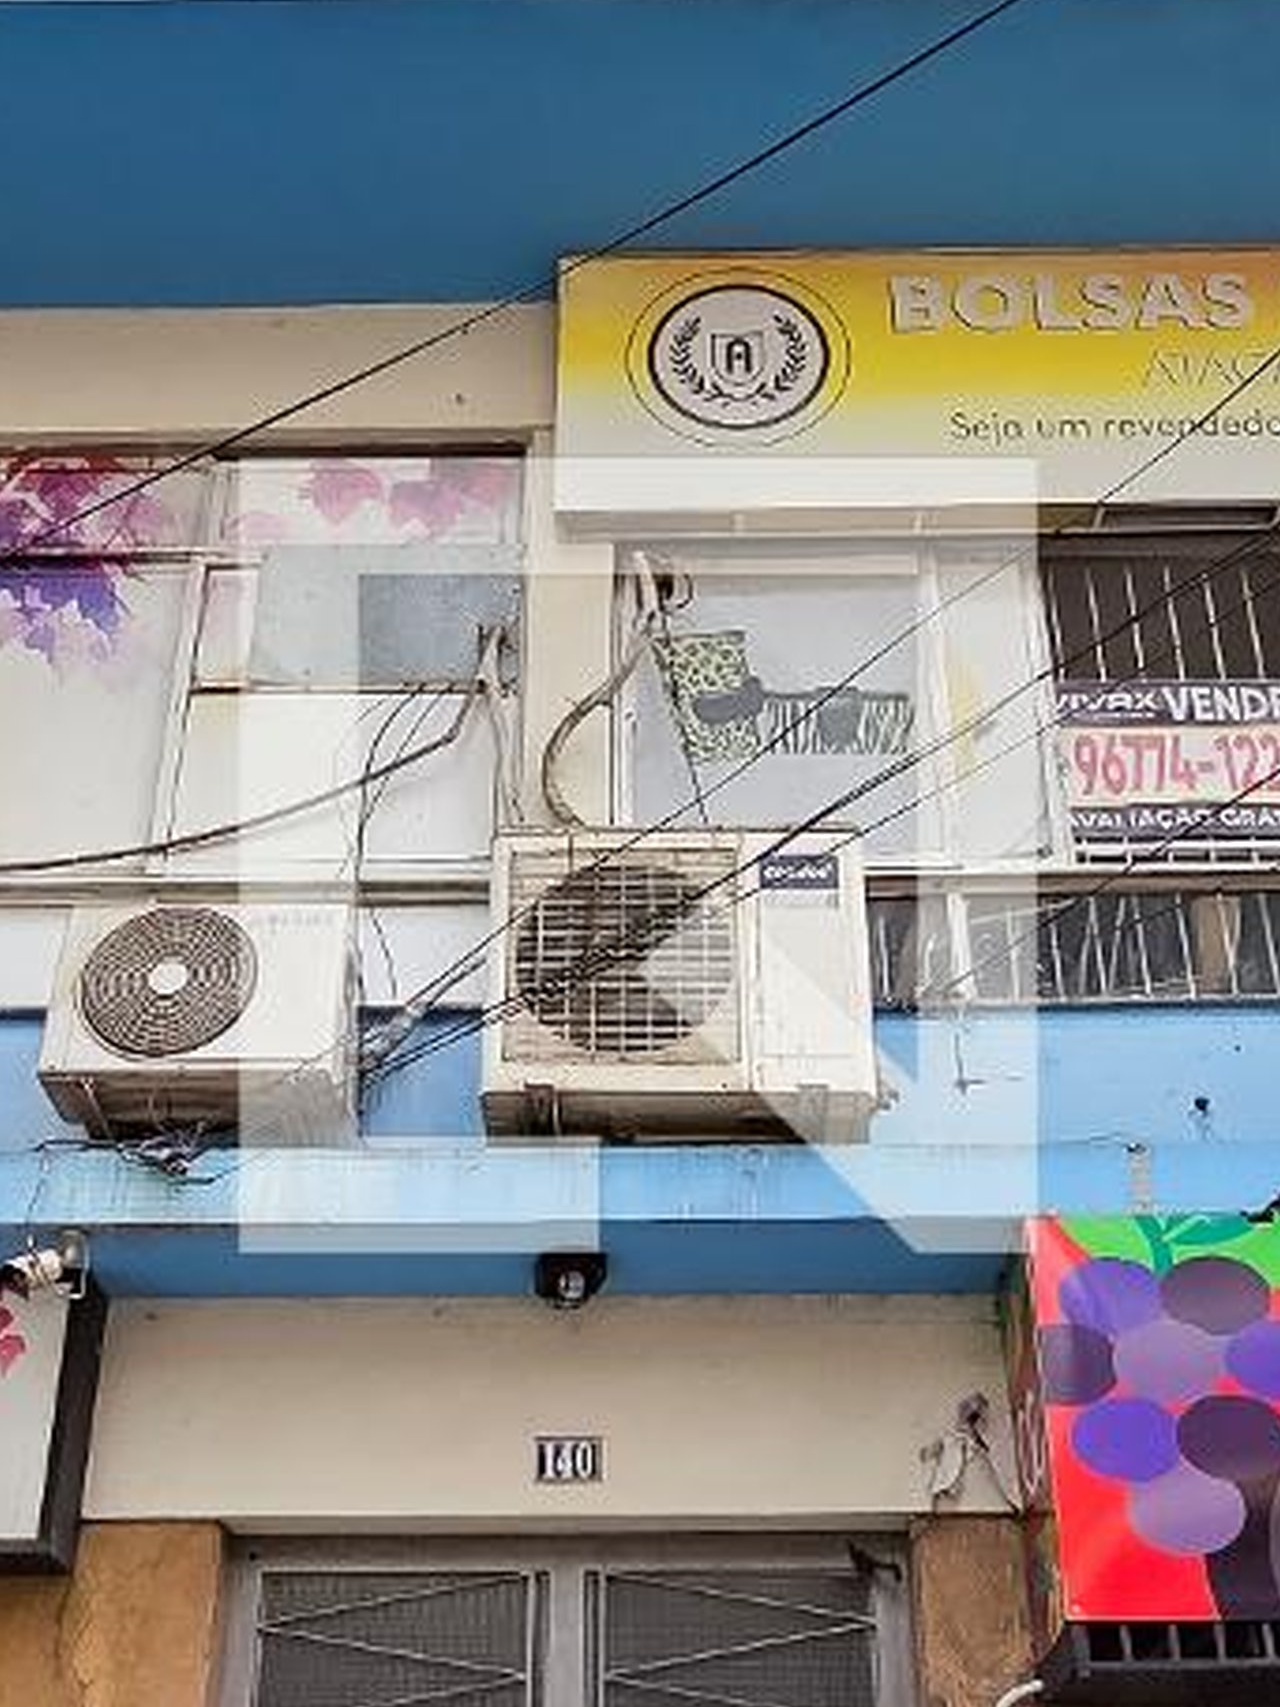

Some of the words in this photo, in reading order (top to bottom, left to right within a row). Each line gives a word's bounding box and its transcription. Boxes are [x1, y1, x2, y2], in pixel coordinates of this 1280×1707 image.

[888, 269, 1250, 334] BOLSAS
[951, 411, 1023, 444] Seja
[1036, 416, 1091, 438] um
